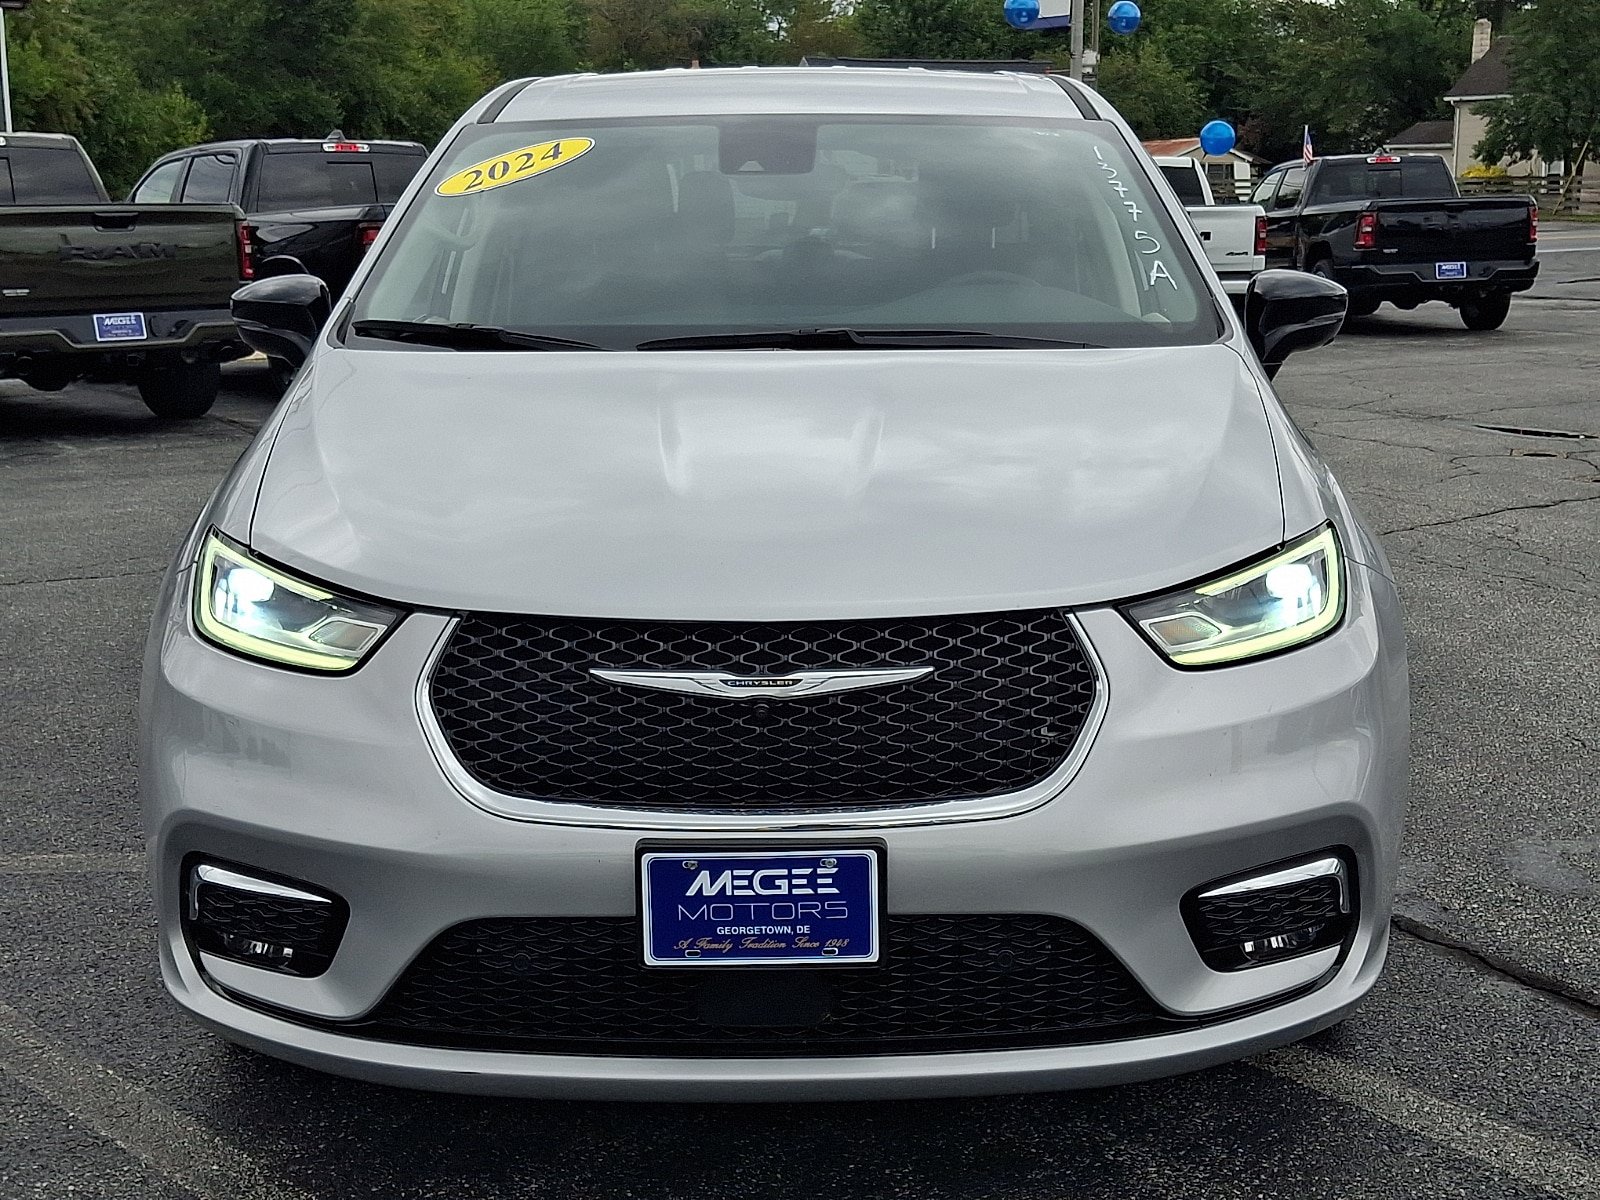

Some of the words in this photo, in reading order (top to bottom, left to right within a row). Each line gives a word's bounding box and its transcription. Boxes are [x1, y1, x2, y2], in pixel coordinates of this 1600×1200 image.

[464, 142, 563, 191] 2024
[685, 867, 840, 897] MEGEE
[677, 901, 848, 921] MOTORS
[716, 926, 794, 935] GEORGETOWN,
[796, 925, 811, 934] DE
[673, 937, 693, 950] A
[693, 937, 733, 953] Family
[738, 937, 787, 949] Tradition
[791, 936, 820, 949] Since
